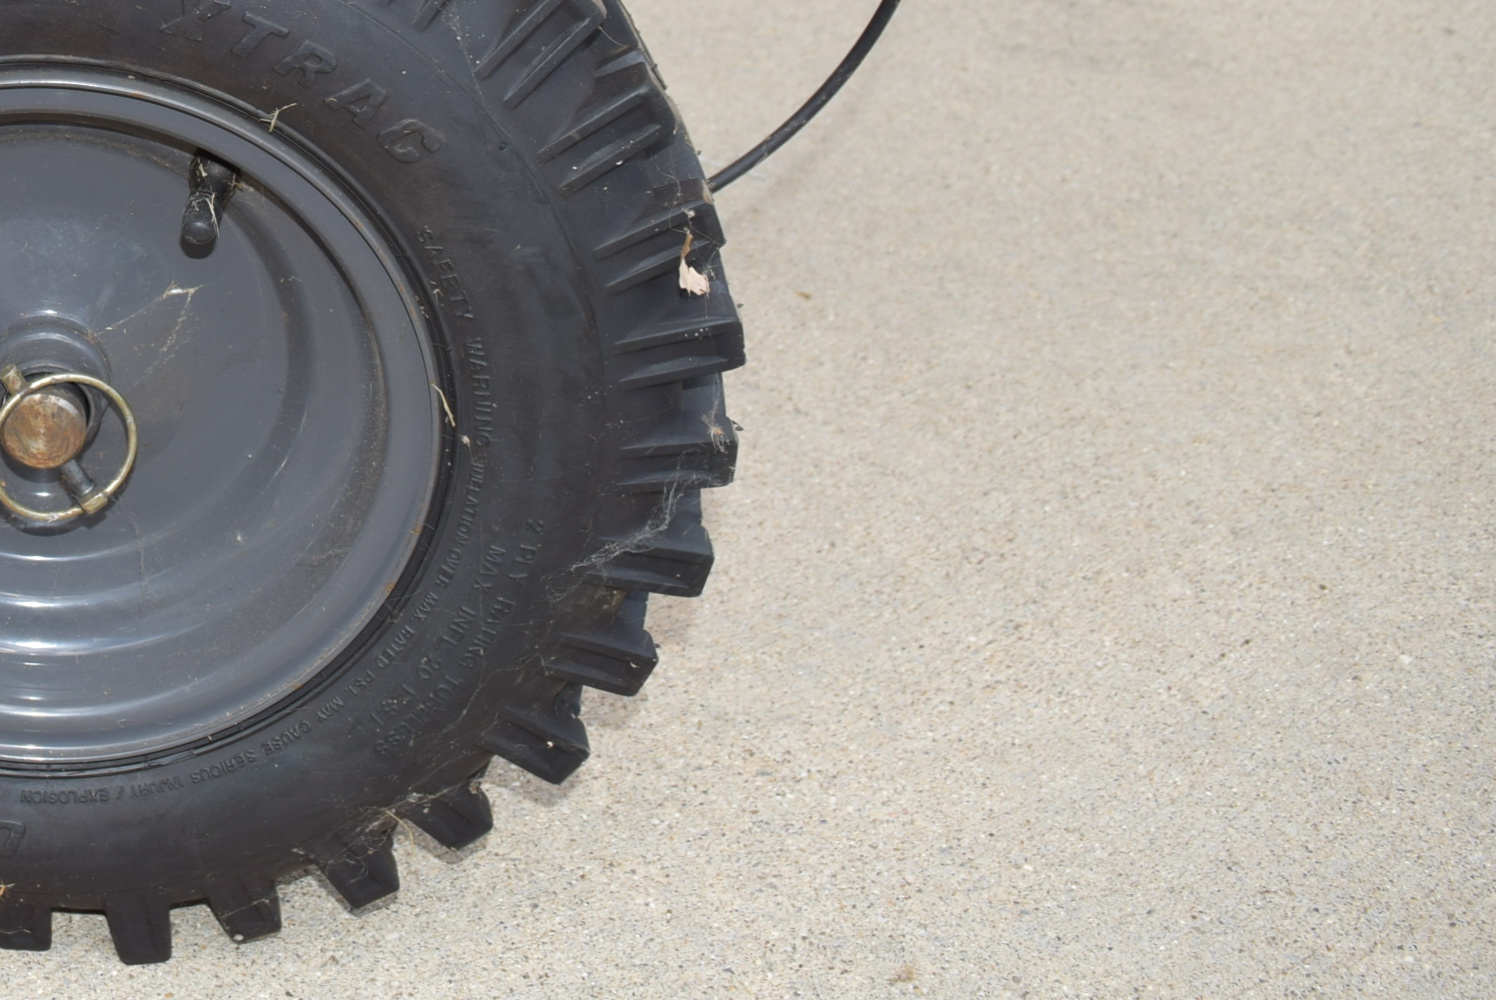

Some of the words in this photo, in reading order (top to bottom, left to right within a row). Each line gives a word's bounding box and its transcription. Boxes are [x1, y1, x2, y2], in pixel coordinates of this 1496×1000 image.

[414, 224, 474, 319] SAFETY
[262, 720, 312, 756] CAUSE
[190, 748, 256, 784] SERIOUS
[20, 787, 111, 805] EXPLOSION
